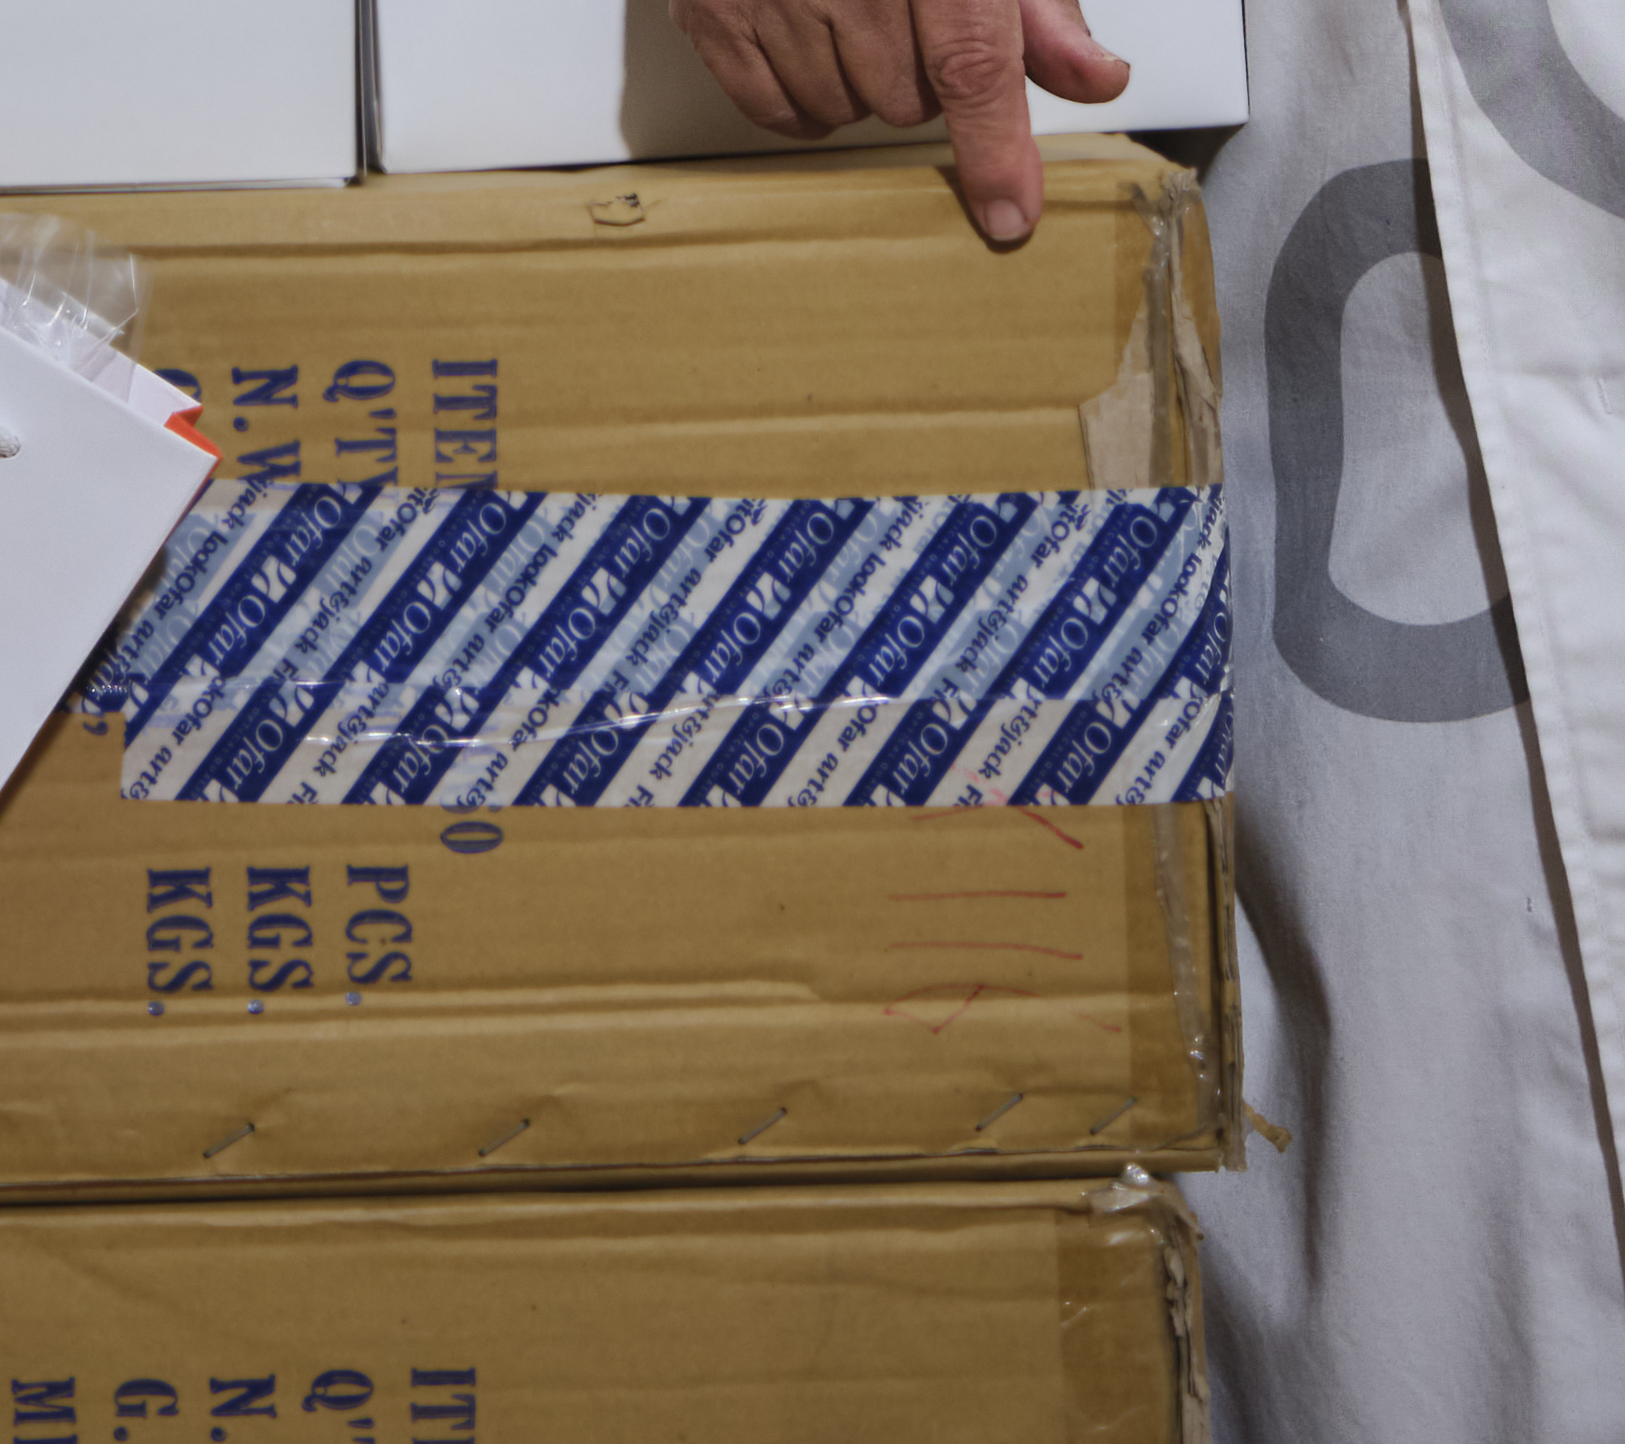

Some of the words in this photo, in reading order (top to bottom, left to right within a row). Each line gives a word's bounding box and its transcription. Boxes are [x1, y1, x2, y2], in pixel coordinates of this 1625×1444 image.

[282, 496, 340, 567] Ofar
[448, 503, 505, 574] Ofar
[612, 509, 669, 580] Ofar
[776, 513, 833, 584] Ofar
[941, 516, 996, 587] Ofar
[1101, 516, 1154, 588] Ofar
[110, 619, 154, 676] art&
[207, 596, 264, 666] Ofar
[373, 602, 430, 674] Ofar
[537, 608, 594, 679] Ofar
[702, 613, 759, 685] Ofar
[869, 616, 923, 688] Ofar
[1032, 618, 1085, 691] Ofar
[225, 720, 281, 791] Ofar
[390, 724, 447, 795] Ofar
[562, 726, 618, 796] Ofar
[726, 724, 782, 795] Ofar
[892, 723, 946, 796] Ofar
[975, 695, 1041, 779] rt&jack
[1054, 723, 1110, 793] Ofar
[146, 867, 214, 1016] KGS.
[247, 866, 313, 1015] KGS.
[346, 864, 412, 1005] PCS.
[411, 1368, 476, 1444] IT
